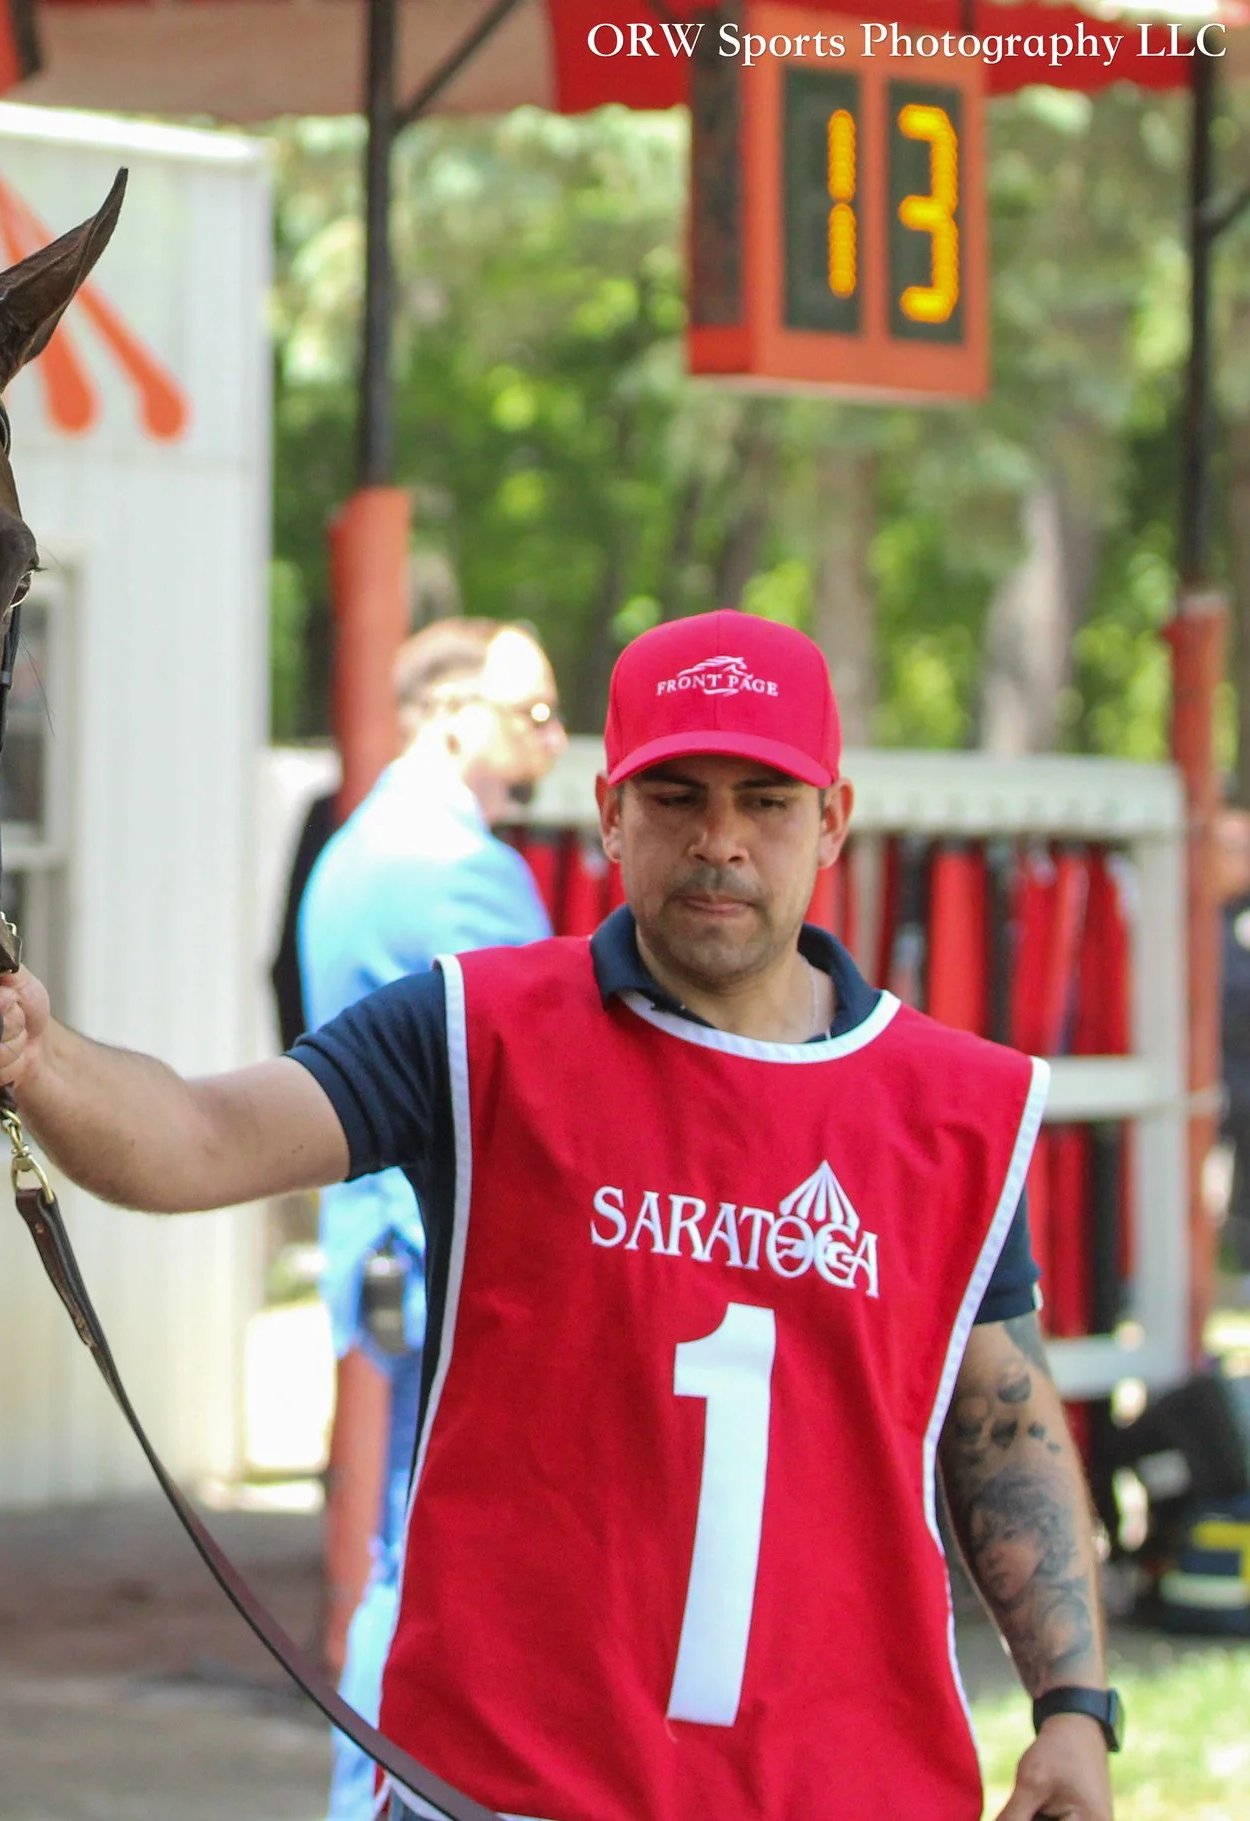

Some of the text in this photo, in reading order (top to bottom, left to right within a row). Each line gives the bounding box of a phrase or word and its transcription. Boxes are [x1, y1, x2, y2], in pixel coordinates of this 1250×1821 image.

[827, 104, 959, 324] 13
[656, 673, 779, 697] FRONT PAGE
[591, 1185, 879, 1299] SARATOGA
[667, 1302, 777, 1727] 1
